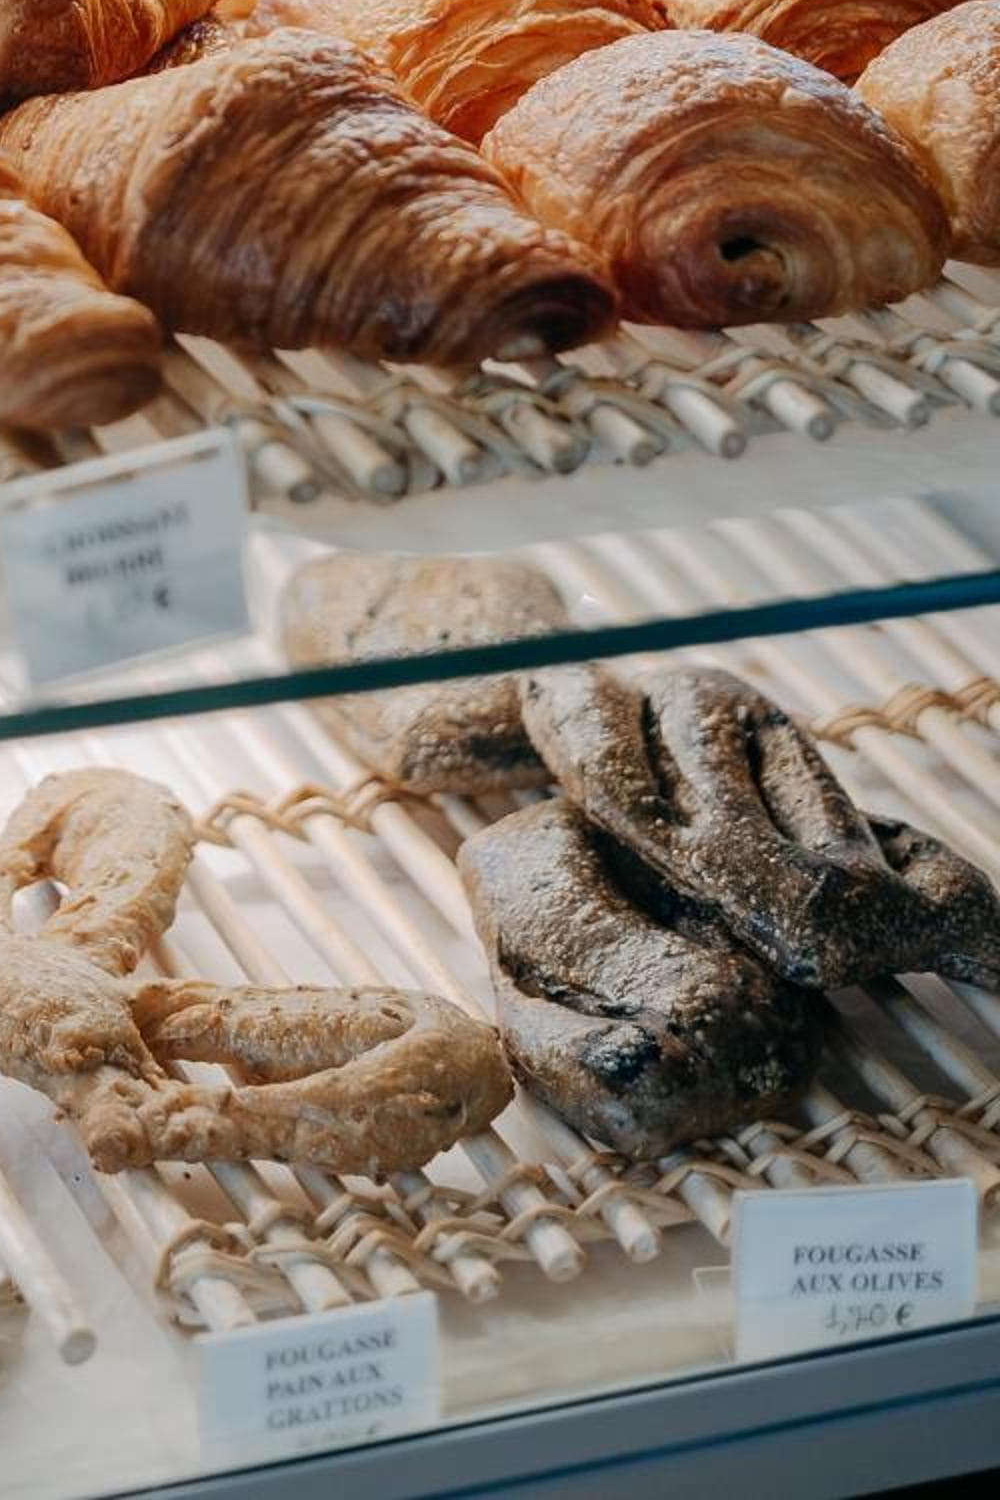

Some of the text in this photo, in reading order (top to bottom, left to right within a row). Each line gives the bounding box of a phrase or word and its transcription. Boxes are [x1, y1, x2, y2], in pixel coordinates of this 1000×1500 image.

[793, 1243, 925, 1265] FOUGASSE
[792, 1271, 944, 1294] AUX OLIVES
[266, 1330, 396, 1370] FOUGASSE
[266, 1361, 385, 1399] PAIN AUX
[266, 1386, 404, 1429] GRATTONS
